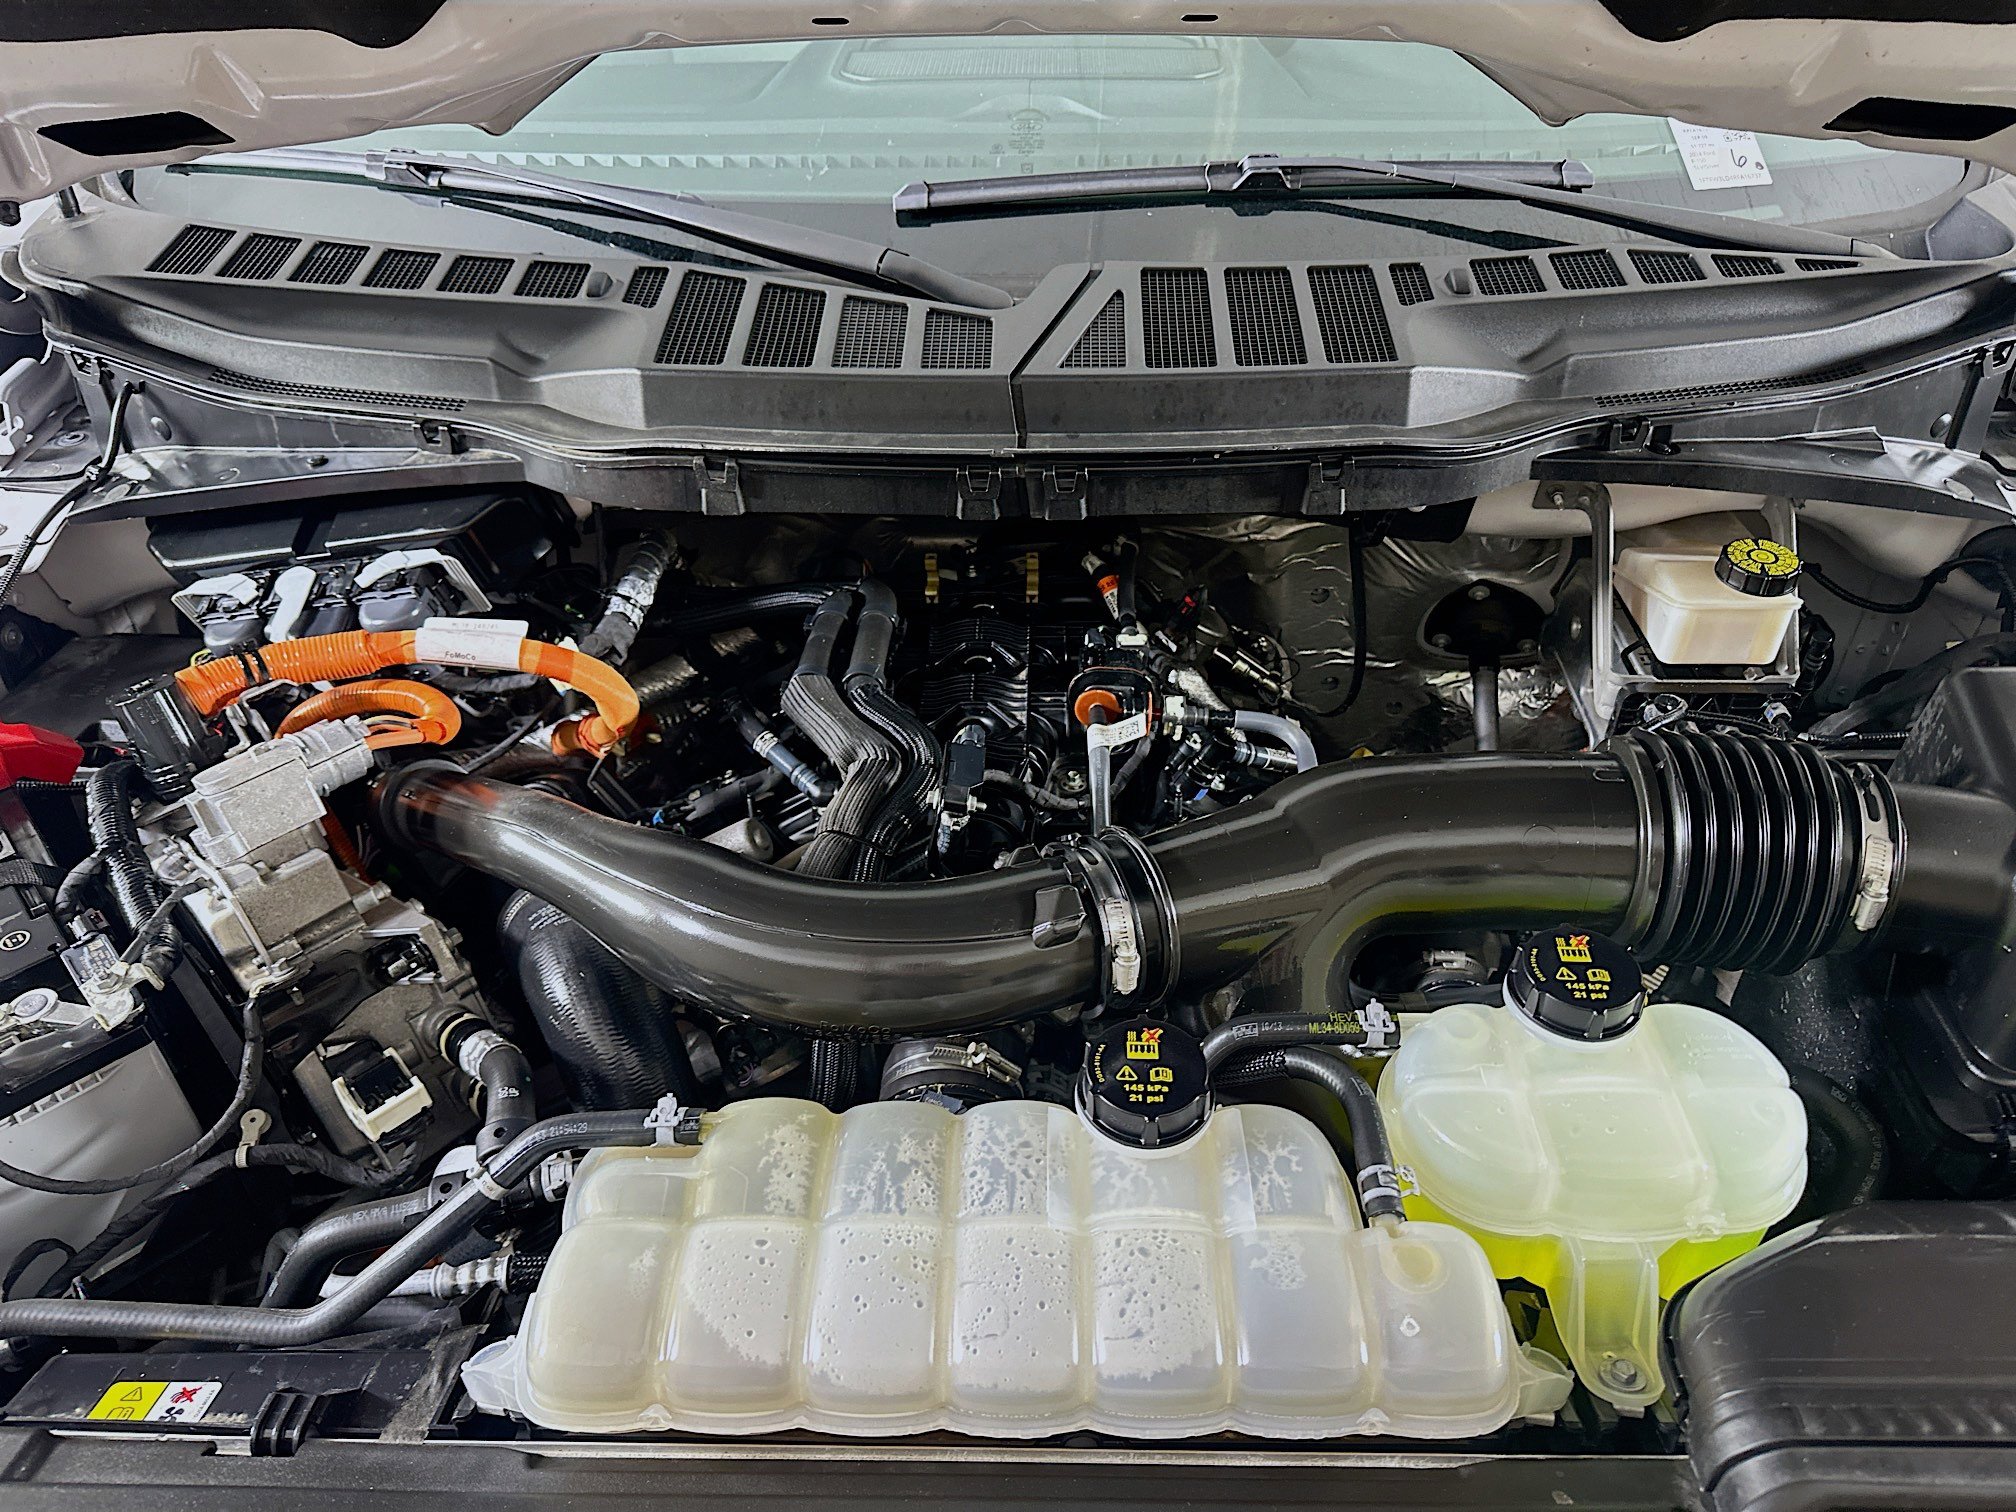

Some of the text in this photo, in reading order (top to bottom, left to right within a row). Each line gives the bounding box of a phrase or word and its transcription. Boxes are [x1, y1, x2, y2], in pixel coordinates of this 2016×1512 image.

[1730, 148, 1748, 168] 6
[444, 651, 477, 661] FoMoCo
[1565, 982, 1610, 991] 145 kPa
[1573, 991, 1607, 1000] 21 psi
[1123, 1084, 1169, 1093] 145 kPa
[1129, 1094, 1164, 1104] 21 psi
